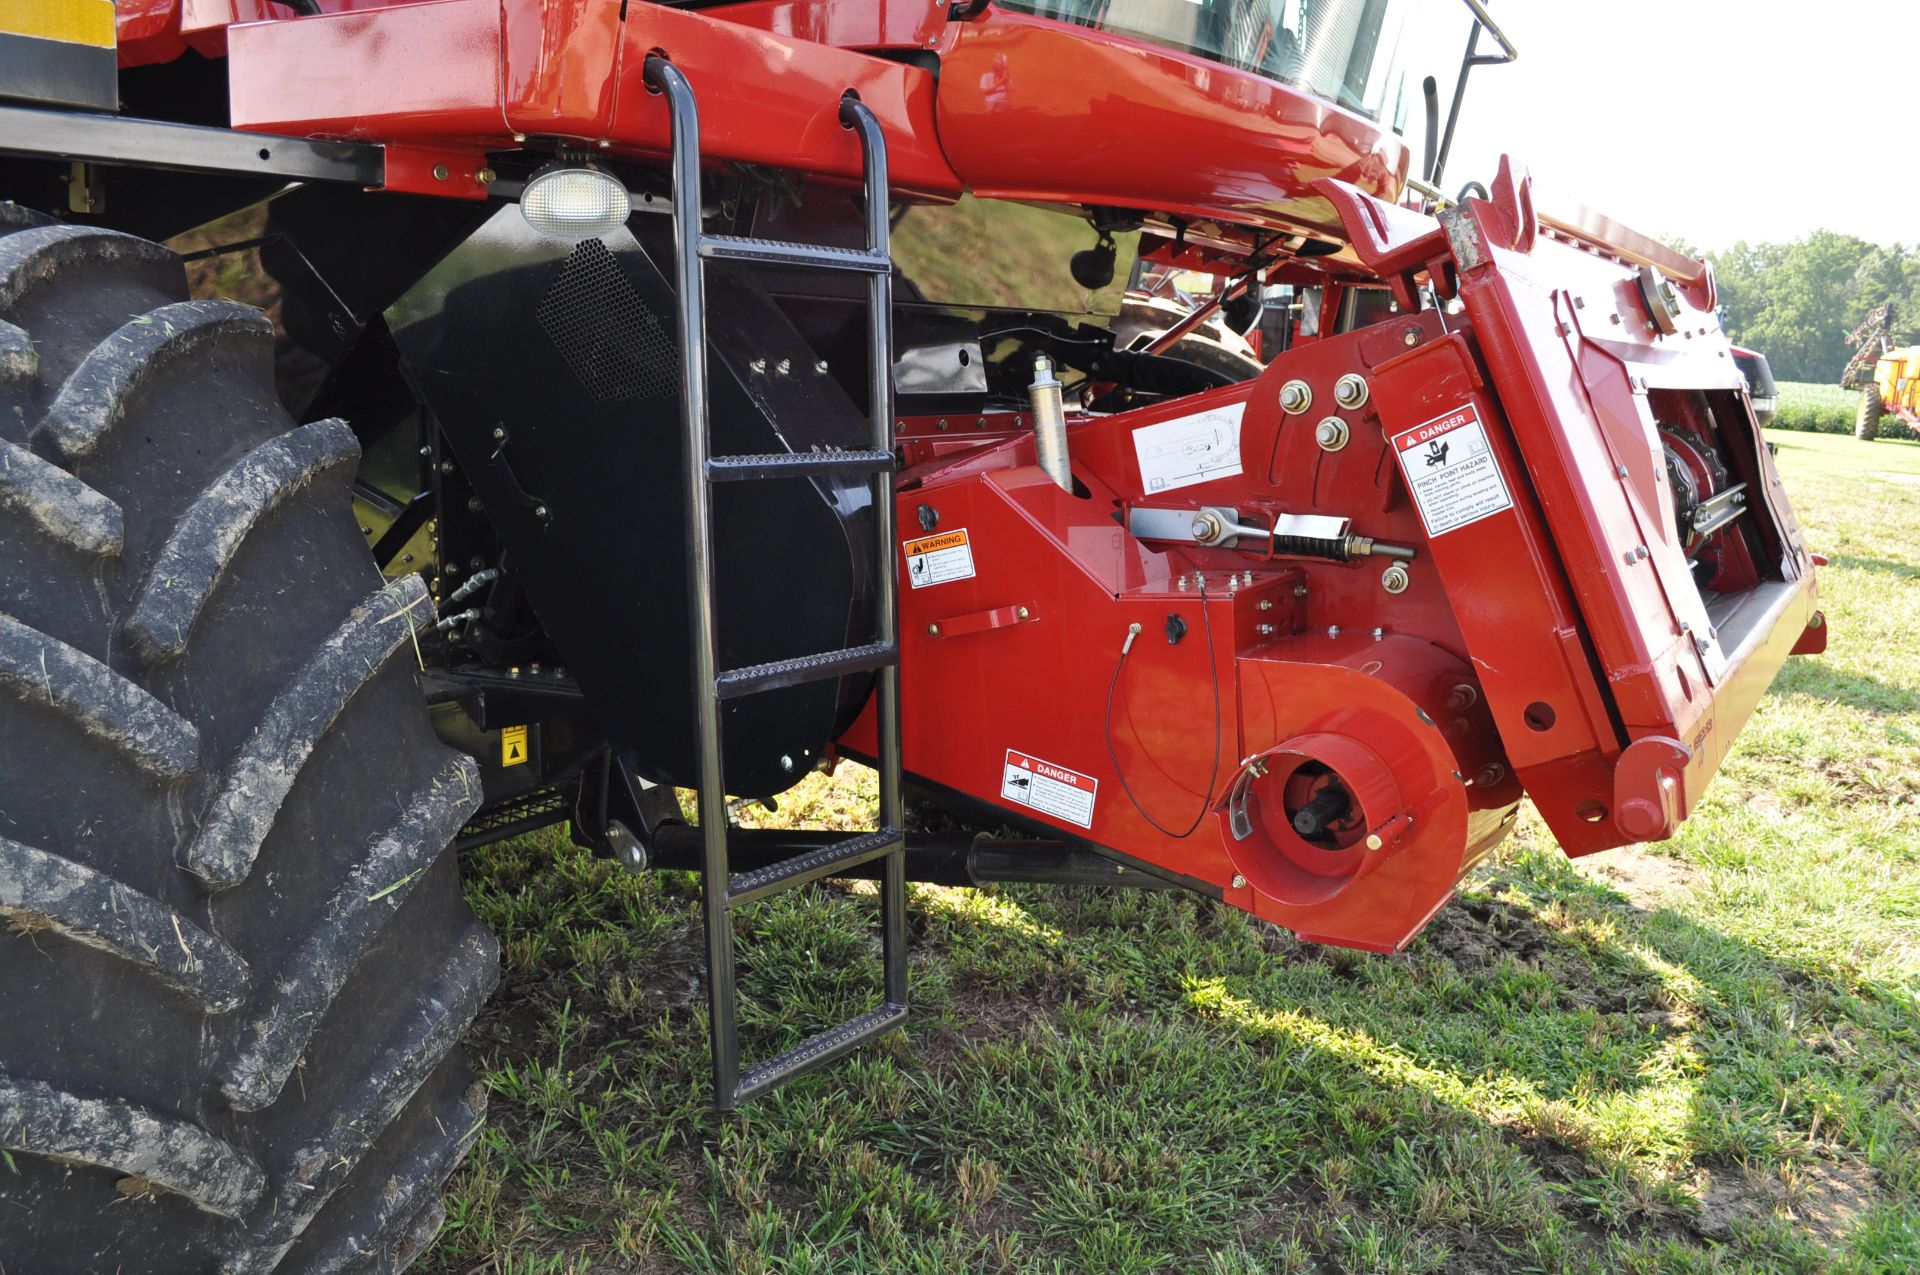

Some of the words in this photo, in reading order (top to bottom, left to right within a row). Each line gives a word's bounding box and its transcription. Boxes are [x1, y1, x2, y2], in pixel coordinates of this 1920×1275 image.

[1419, 414, 1465, 440] DANGER
[1417, 477, 1437, 489] PINCH
[1440, 468, 1459, 480] POINT
[1460, 457, 1488, 472] HAZARD
[1431, 514, 1449, 524] Failure
[922, 535, 961, 550] WARNING
[1037, 764, 1077, 785] DANGER
